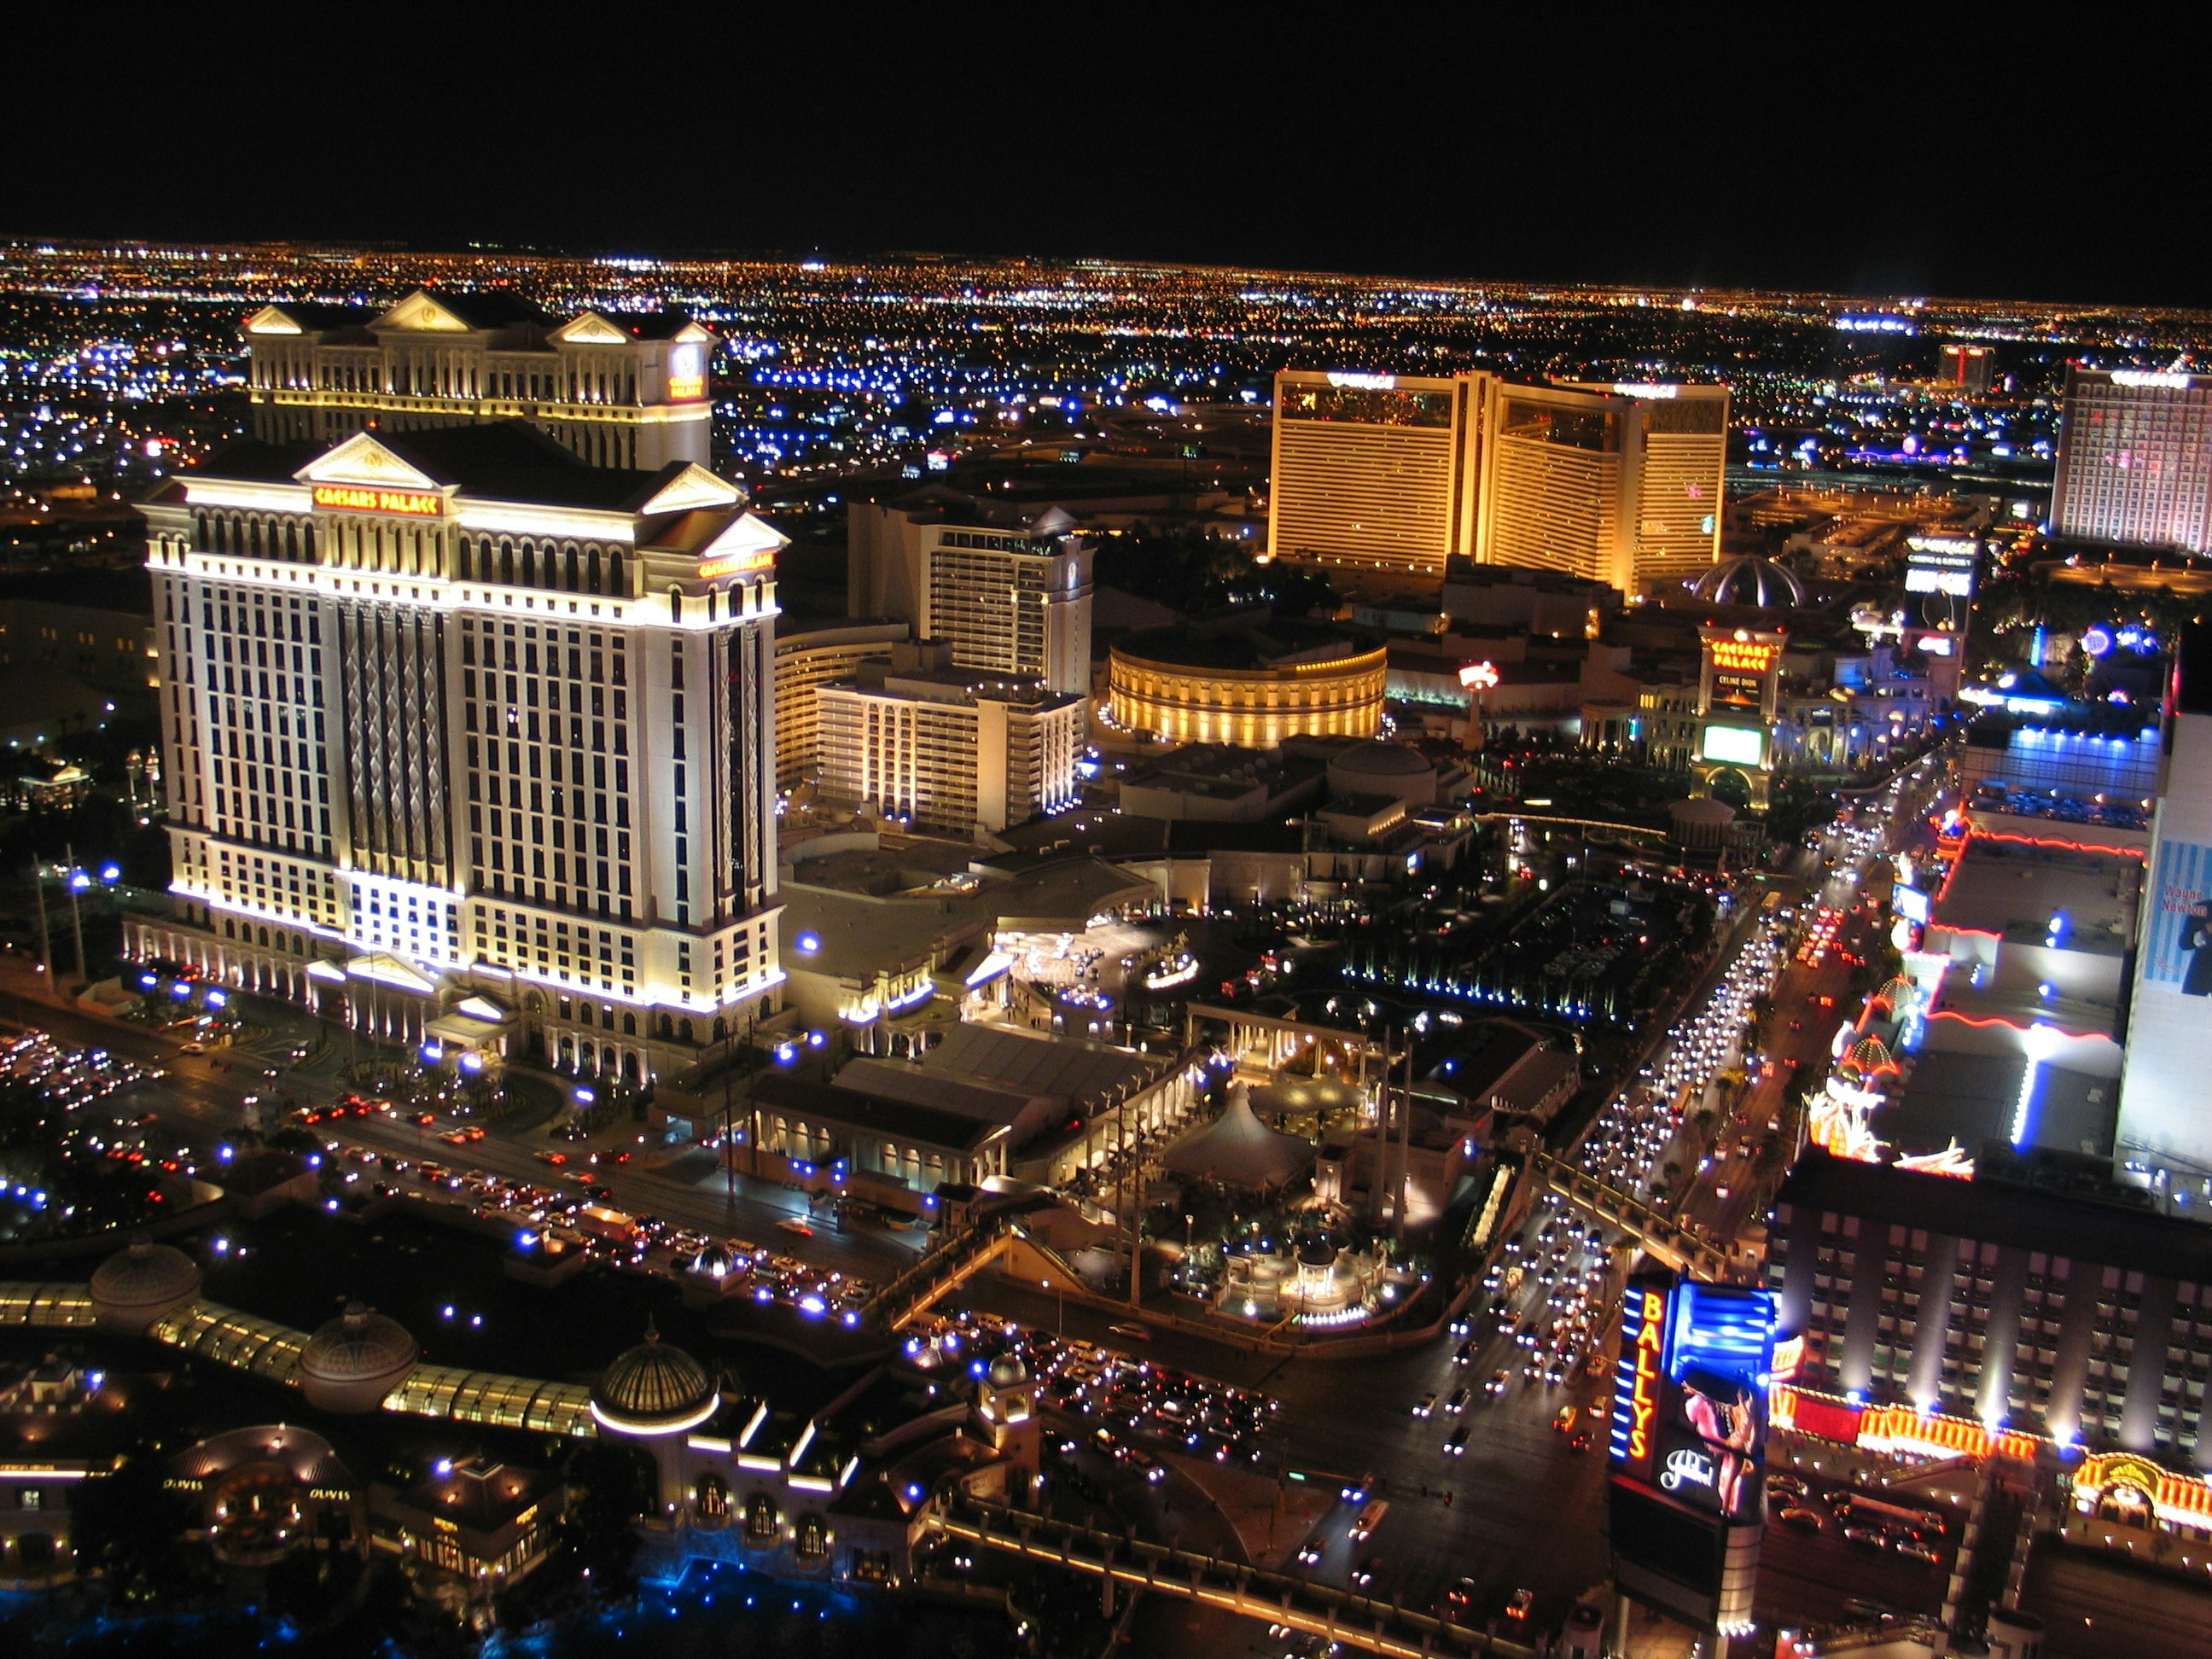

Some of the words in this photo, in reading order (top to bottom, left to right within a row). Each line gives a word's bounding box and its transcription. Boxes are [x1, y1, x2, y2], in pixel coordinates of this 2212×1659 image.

[315, 487, 377, 509] CAESARS
[380, 492, 438, 514] PALACE
[1711, 641, 1771, 658] CAESARS
[1713, 654, 1767, 672] PALACE
[1719, 675, 1740, 686] CELINE
[1741, 678, 1757, 688] DION
[2165, 885, 2203, 900] Wayne
[2163, 899, 2209, 917] Newton
[309, 1488, 352, 1501] OLIVES
